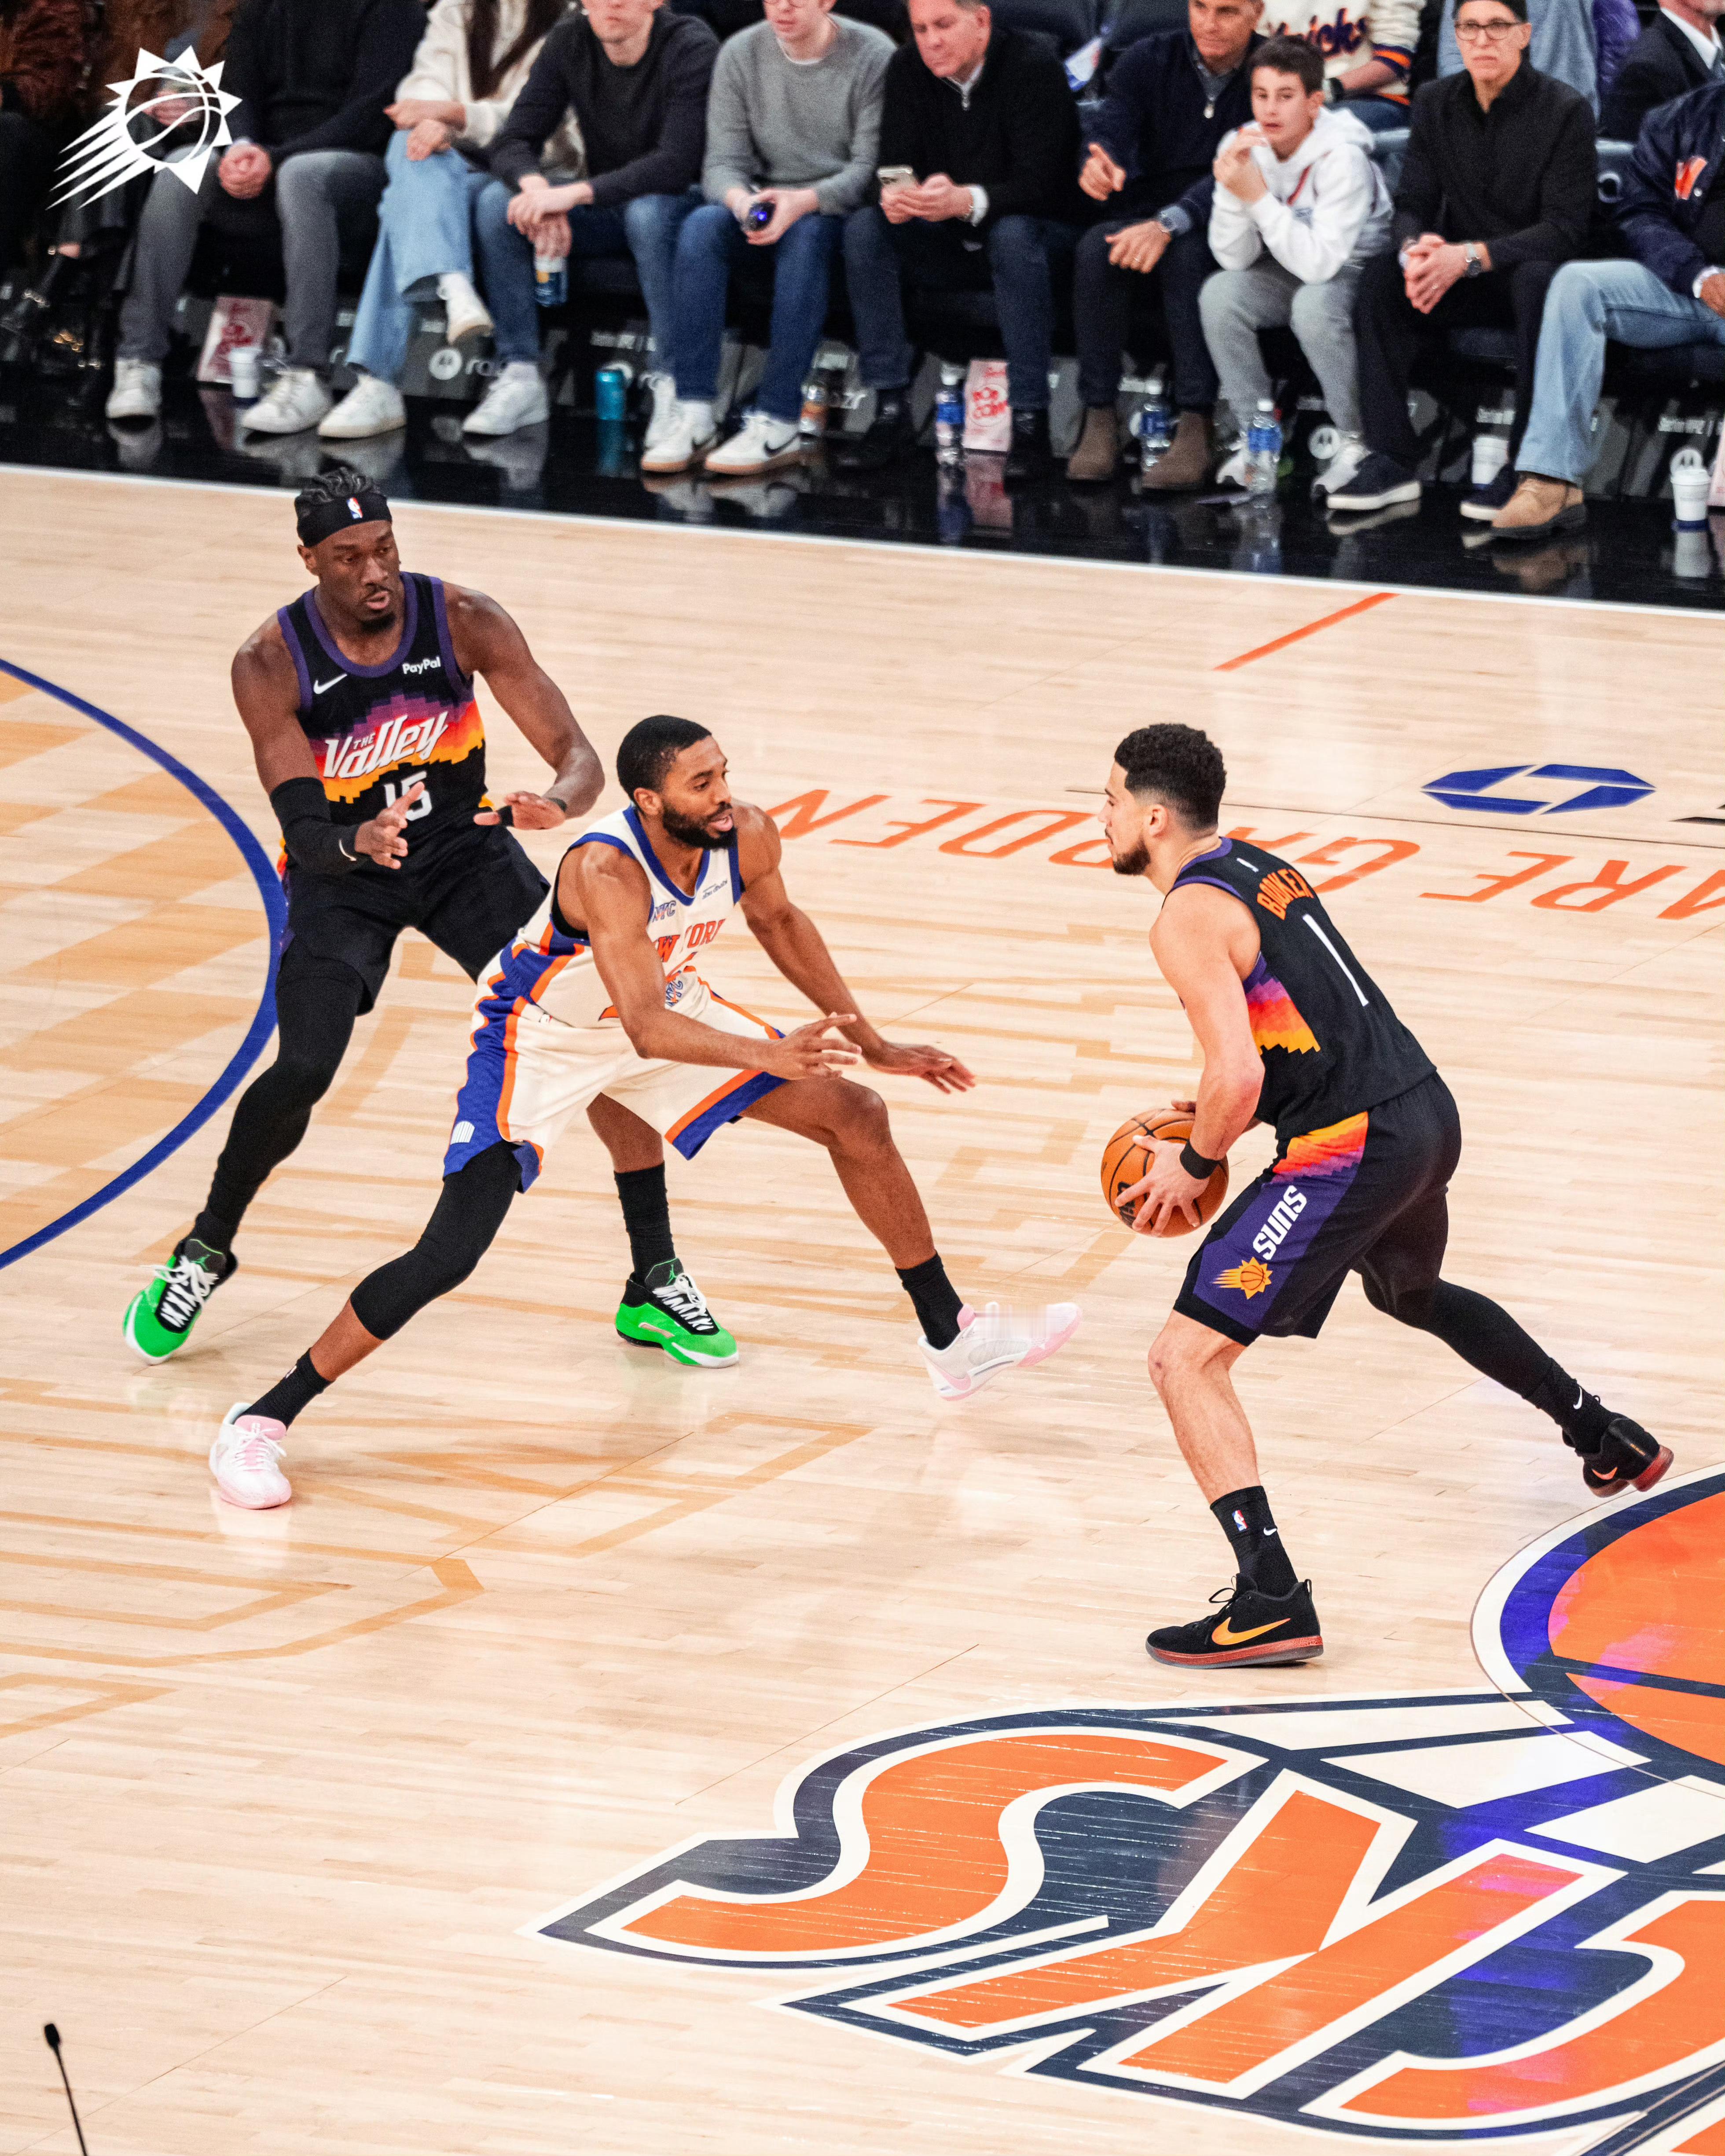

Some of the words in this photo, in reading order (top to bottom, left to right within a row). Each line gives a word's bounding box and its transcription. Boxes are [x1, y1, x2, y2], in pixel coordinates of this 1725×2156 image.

[402, 656, 441, 675] PayPal
[323, 711, 448, 779] Valley
[353, 732, 376, 750] THE
[384, 771, 433, 821] 15
[1303, 913, 1369, 1007] 1
[1252, 1184, 1307, 1261] SUNS
[581, 1723, 1725, 2156] CKS
